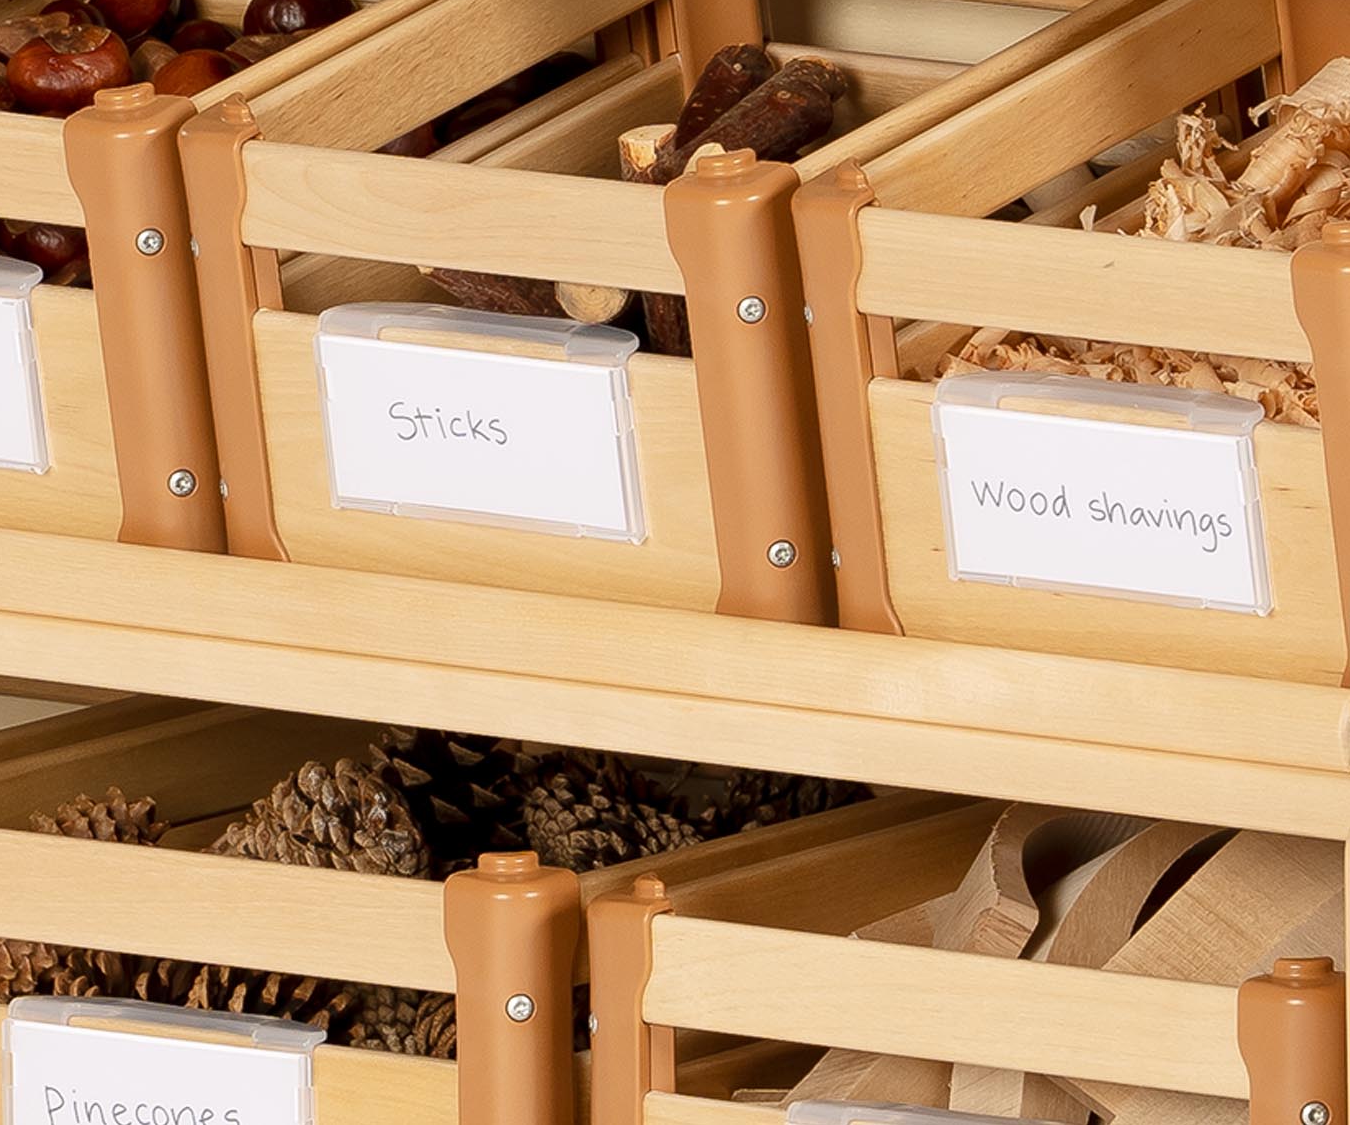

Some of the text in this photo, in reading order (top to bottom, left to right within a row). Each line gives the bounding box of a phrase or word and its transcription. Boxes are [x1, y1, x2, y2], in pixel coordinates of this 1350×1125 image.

[388, 401, 508, 445] Sticks
[970, 480, 1233, 553] Wood shavings
[44, 1085, 240, 1125] Pinecones
